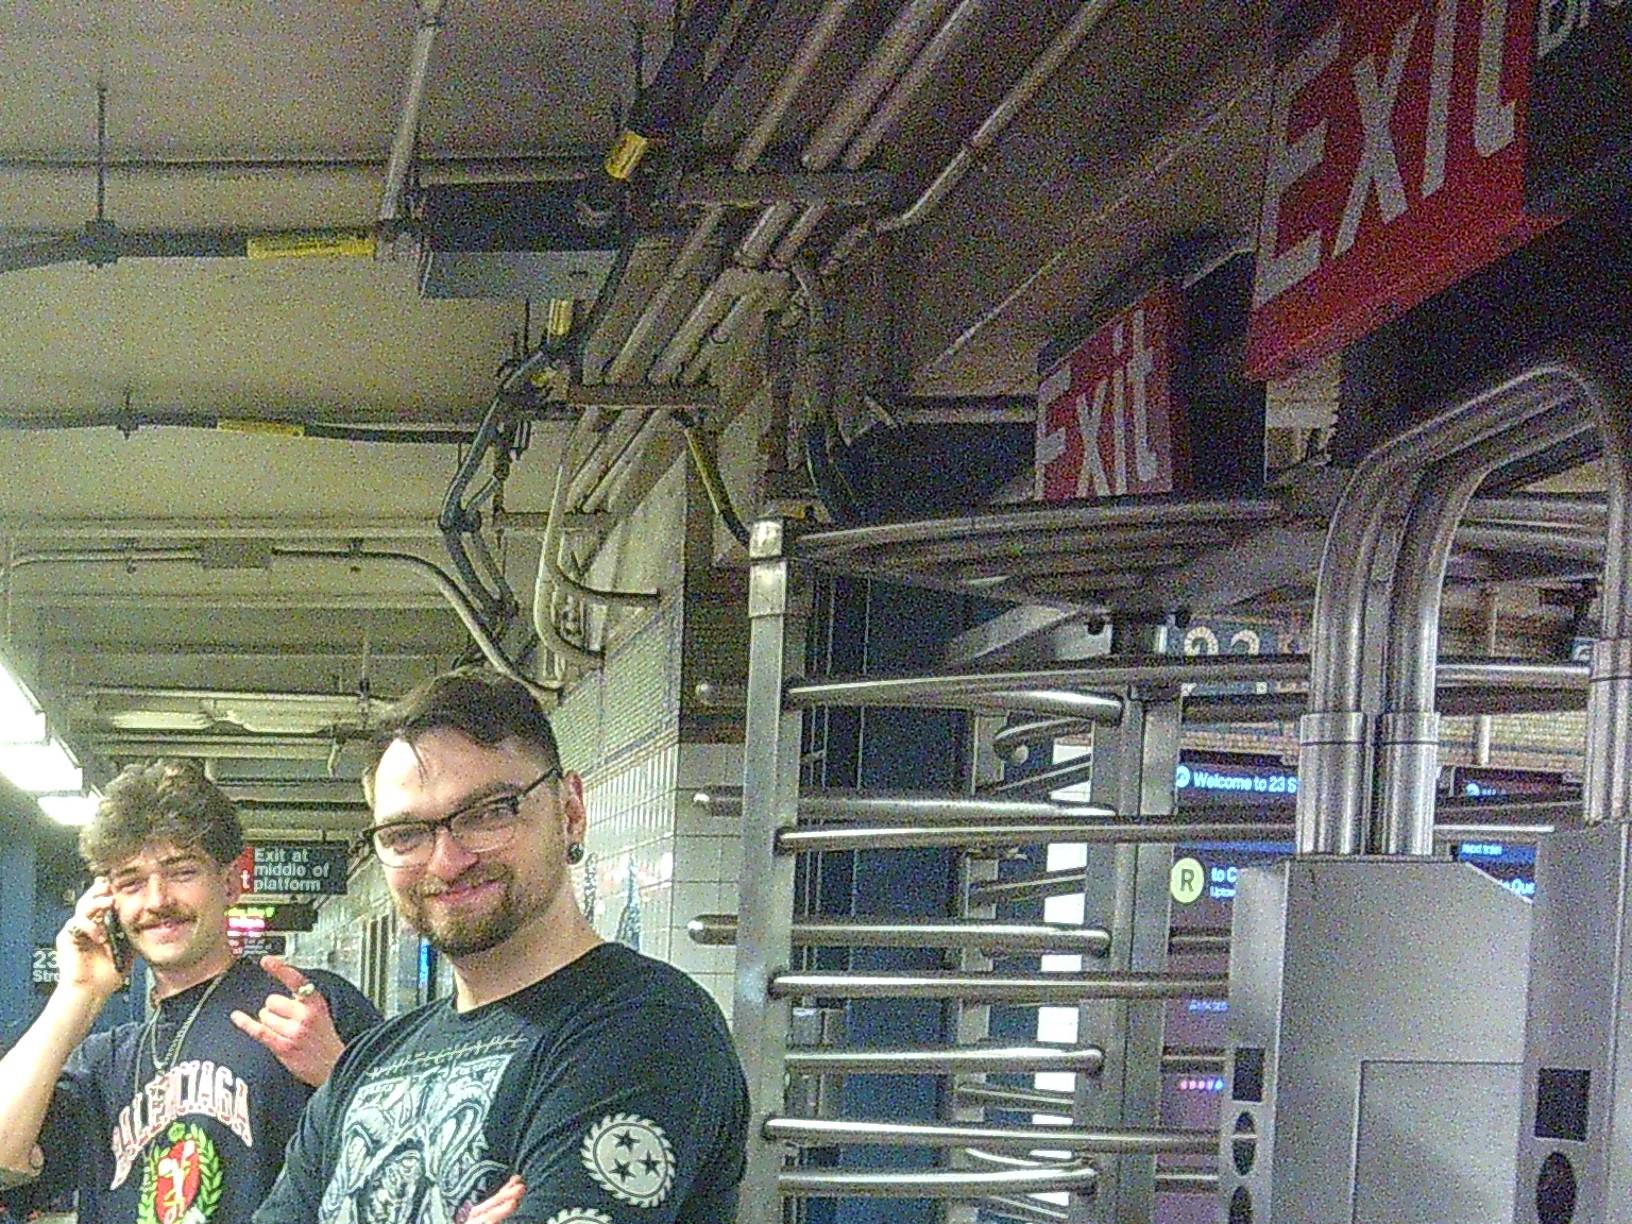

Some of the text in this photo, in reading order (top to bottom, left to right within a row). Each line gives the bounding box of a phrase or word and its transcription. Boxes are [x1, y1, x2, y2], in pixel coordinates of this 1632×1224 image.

[1192, 770, 1252, 791] Welcome
[1253, 775, 1267, 792] to
[1268, 776, 1286, 793] 23
[254, 847, 310, 862] Exit at
[254, 862, 330, 878] middle of
[254, 877, 321, 892] platform
[1179, 868, 1194, 893] R
[1211, 867, 1225, 883] to
[32, 950, 59, 969] 23
